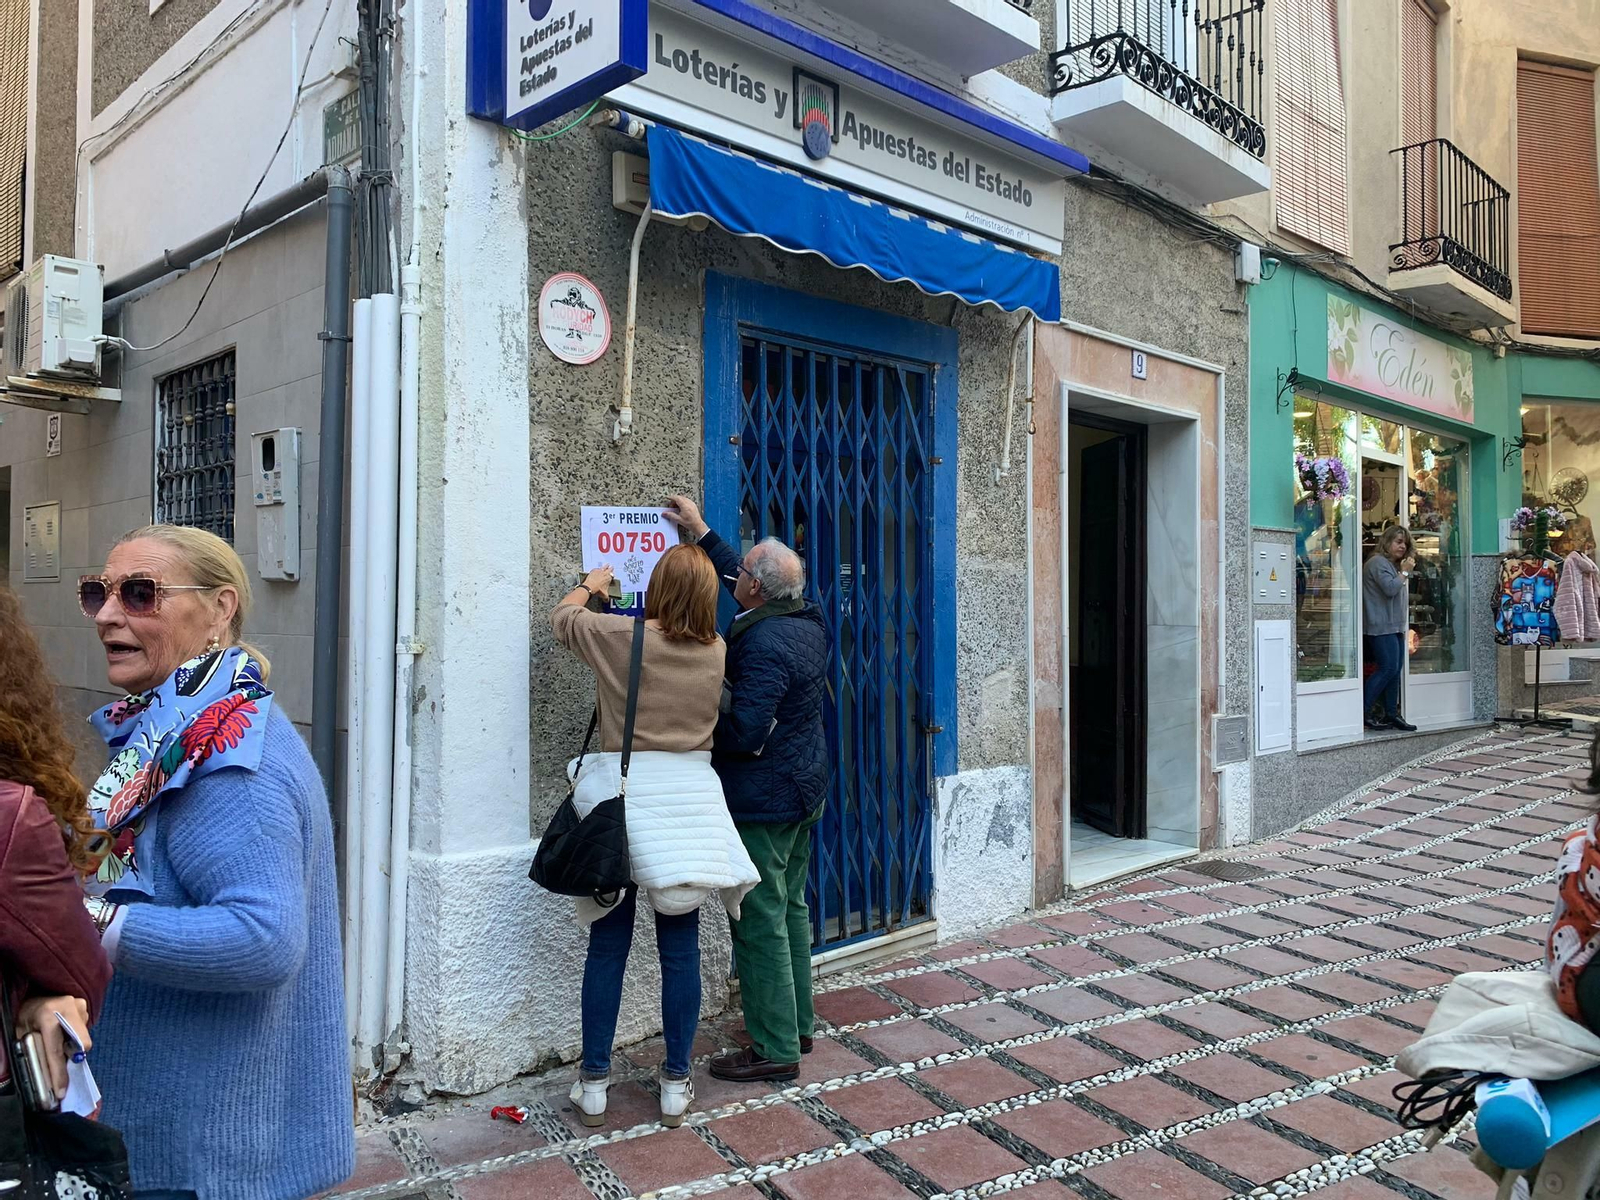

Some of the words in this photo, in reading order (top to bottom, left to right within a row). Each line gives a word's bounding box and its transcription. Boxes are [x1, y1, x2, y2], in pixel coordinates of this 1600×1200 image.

[520, 16, 566, 53] Loterías
[568, 10, 576, 30] y
[520, 35, 572, 75] Apuestas
[575, 18, 593, 44] del
[519, 65, 557, 98] Estado
[655, 33, 766, 104] Loterías
[774, 88, 788, 119] y
[842, 111, 937, 170] Apuestas
[942, 151, 970, 184] del
[975, 163, 1033, 207] Estado
[965, 211, 1015, 237] Administración
[1137, 354, 1143, 374] 9
[1370, 323, 1437, 400] Edén
[619, 513, 659, 524] PREMIO
[597, 532, 666, 554] 00750
